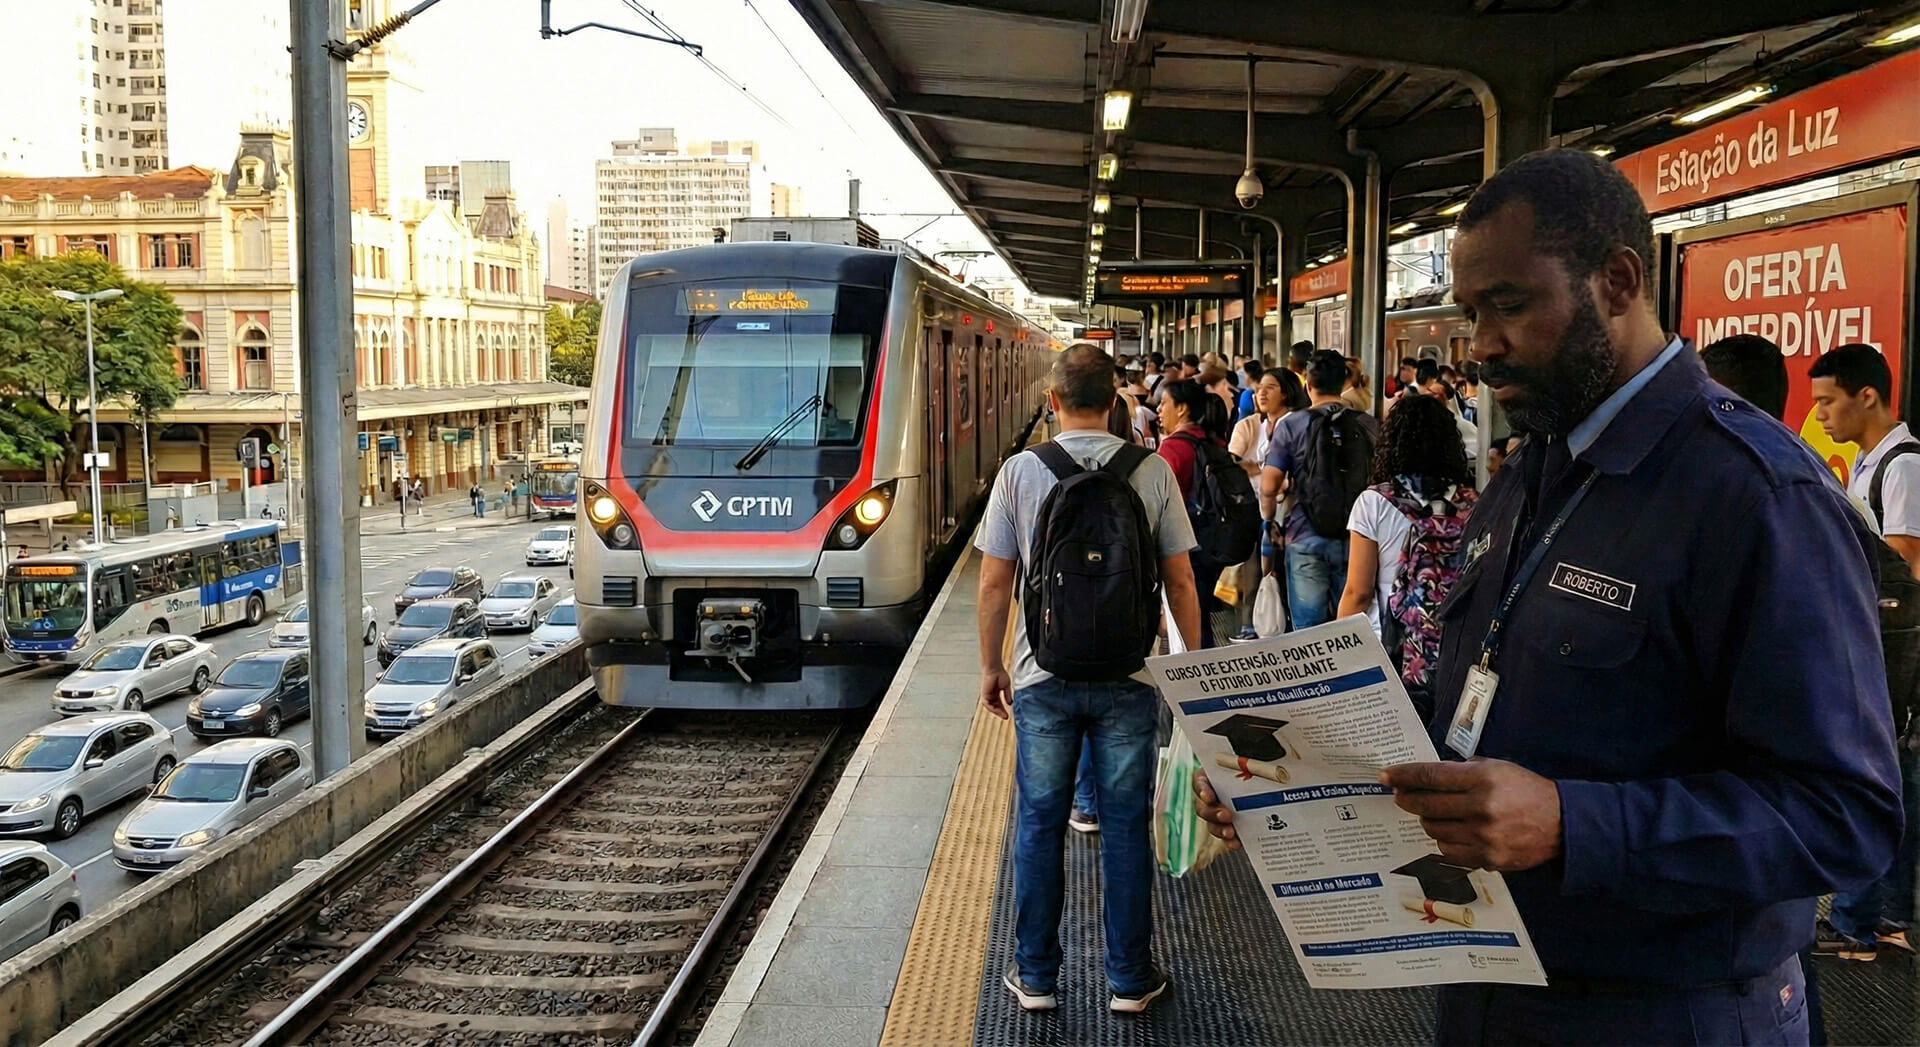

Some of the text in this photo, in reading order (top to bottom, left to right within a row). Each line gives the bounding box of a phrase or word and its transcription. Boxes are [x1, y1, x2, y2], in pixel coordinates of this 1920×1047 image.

[1657, 106, 1840, 195] Estação da Luz
[1724, 243, 1848, 302] OFERTA
[727, 496, 793, 516] CPTM
[1562, 571, 1620, 600] ROBERTO
[1165, 633, 1363, 681] CURSO DE EXTENSÃO: PONTE PARA
[1200, 658, 1337, 693] O FUTURO DO VIGILANTE
[1266, 692, 1277, 703] da
[1277, 683, 1331, 702] Qualificação
